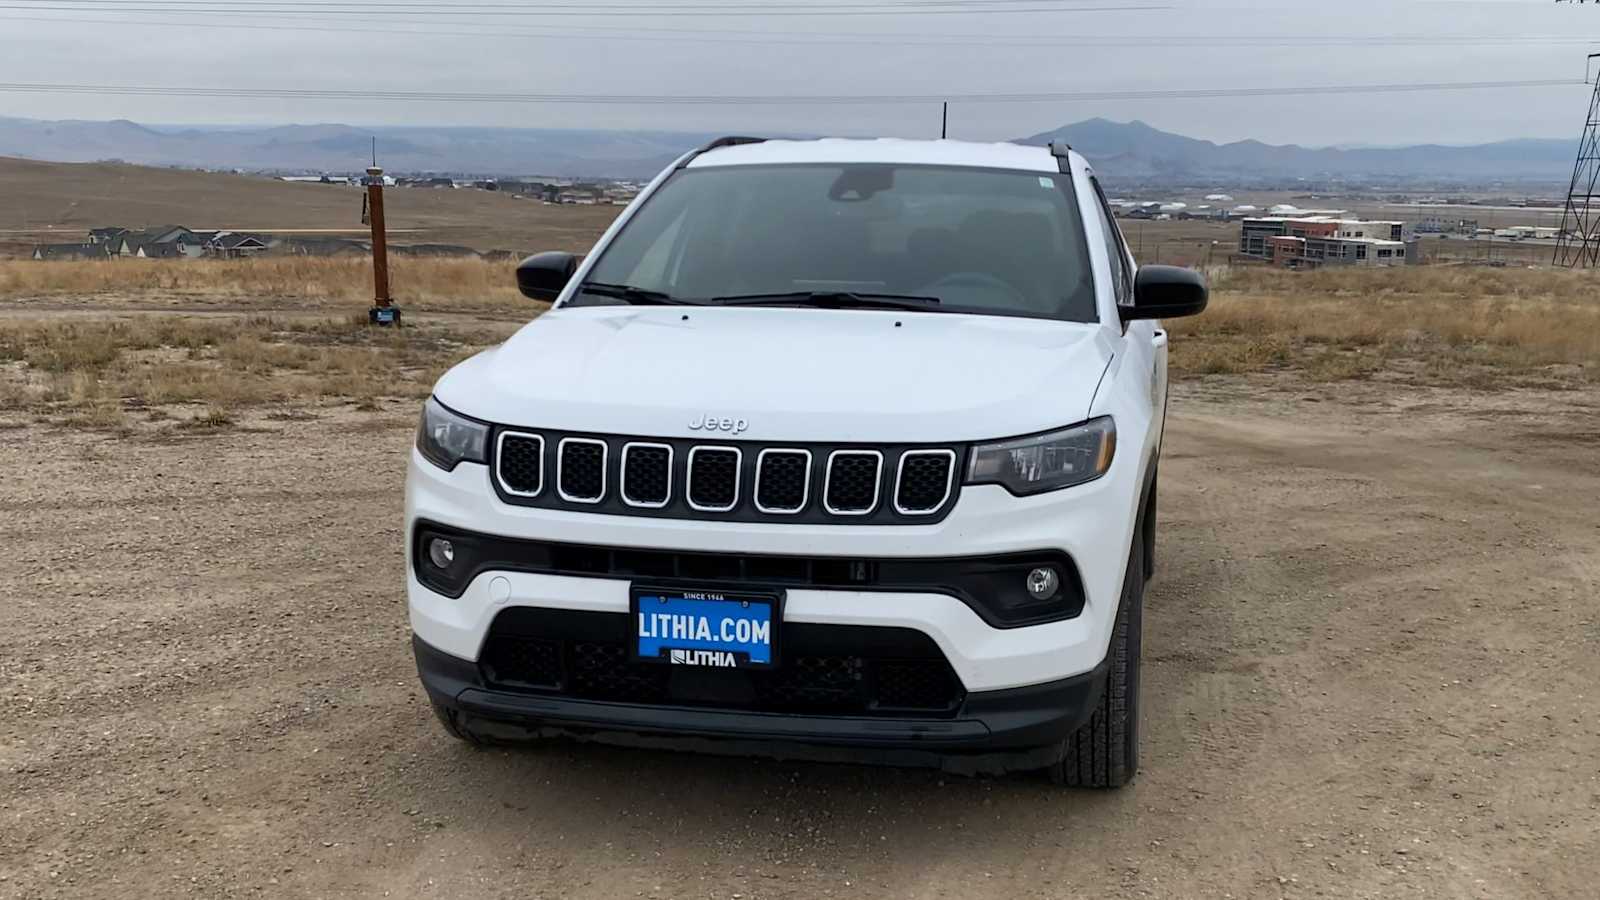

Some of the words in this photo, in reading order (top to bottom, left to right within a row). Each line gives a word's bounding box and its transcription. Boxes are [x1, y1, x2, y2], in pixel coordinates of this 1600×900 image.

[688, 413, 749, 435] Jeep
[683, 592, 705, 600] SINCE
[638, 612, 770, 644] LITHIA.COM
[686, 650, 736, 667] LITHIA
